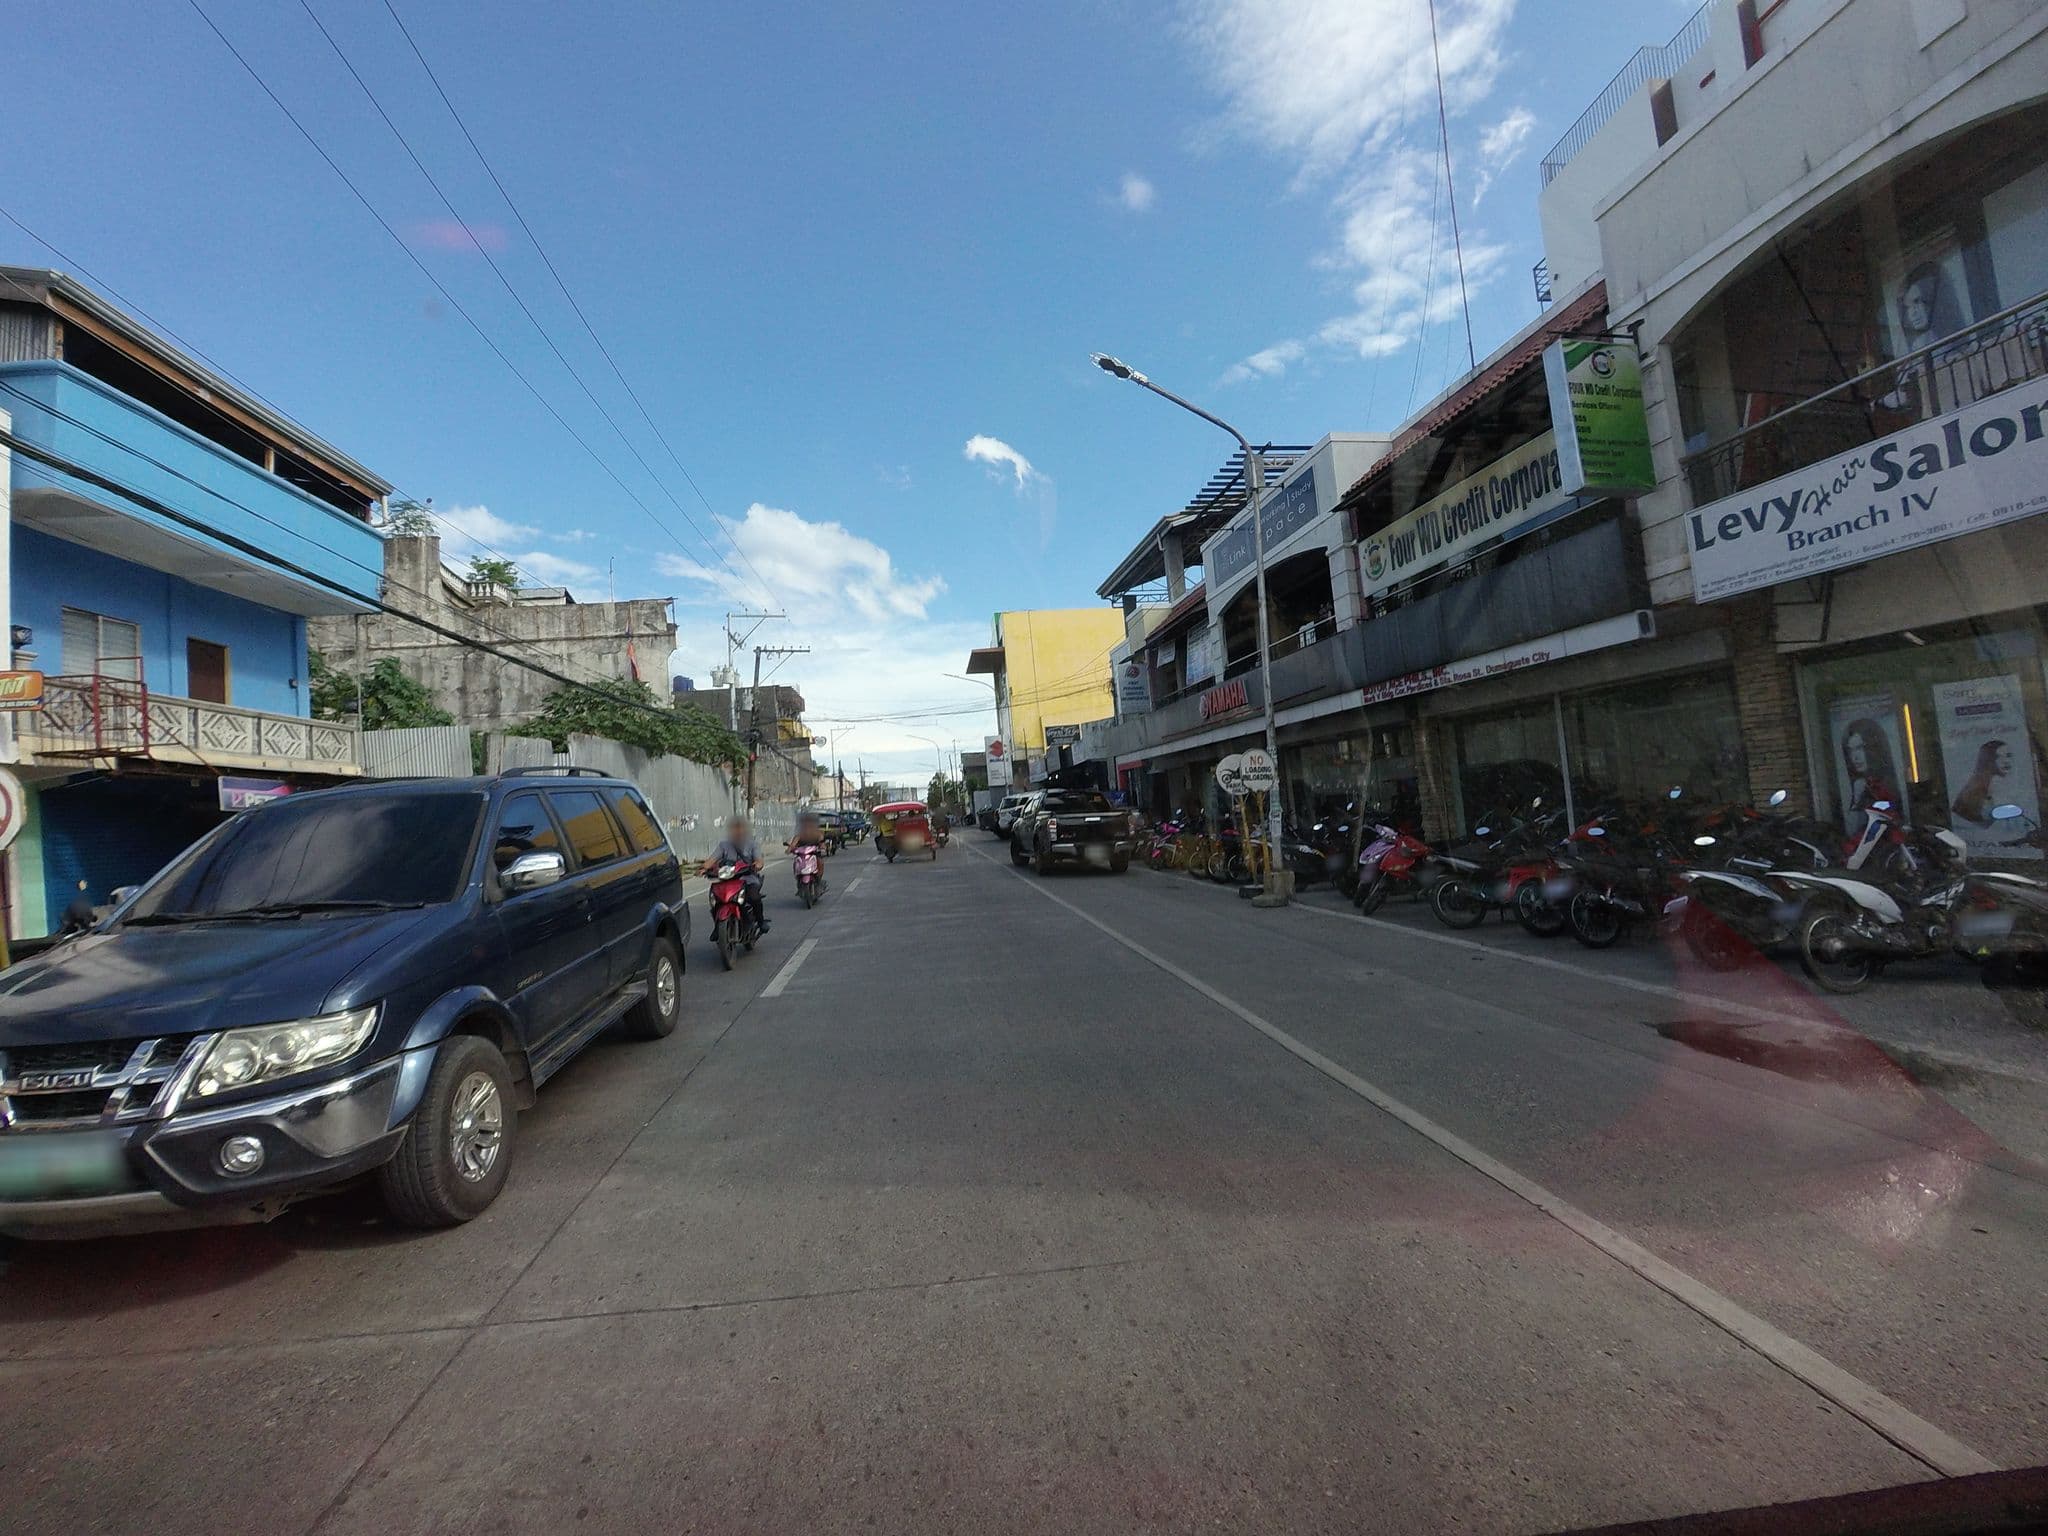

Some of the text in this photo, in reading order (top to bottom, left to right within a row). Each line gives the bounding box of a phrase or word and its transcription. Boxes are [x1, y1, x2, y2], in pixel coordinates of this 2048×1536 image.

[1690, 488, 1803, 551] Levy
[1802, 455, 1866, 516] Hair
[1787, 505, 1889, 551] Branch
[1900, 486, 1939, 517] IV
[1390, 530, 1417, 572] Four
[1415, 510, 1443, 557] WD
[1442, 485, 1491, 546] Credit
[1532, 650, 1551, 664] City
[1207, 680, 1249, 716] YAMAHA
[1244, 766, 1272, 774] LOADING
[1249, 755, 1264, 766] NO
